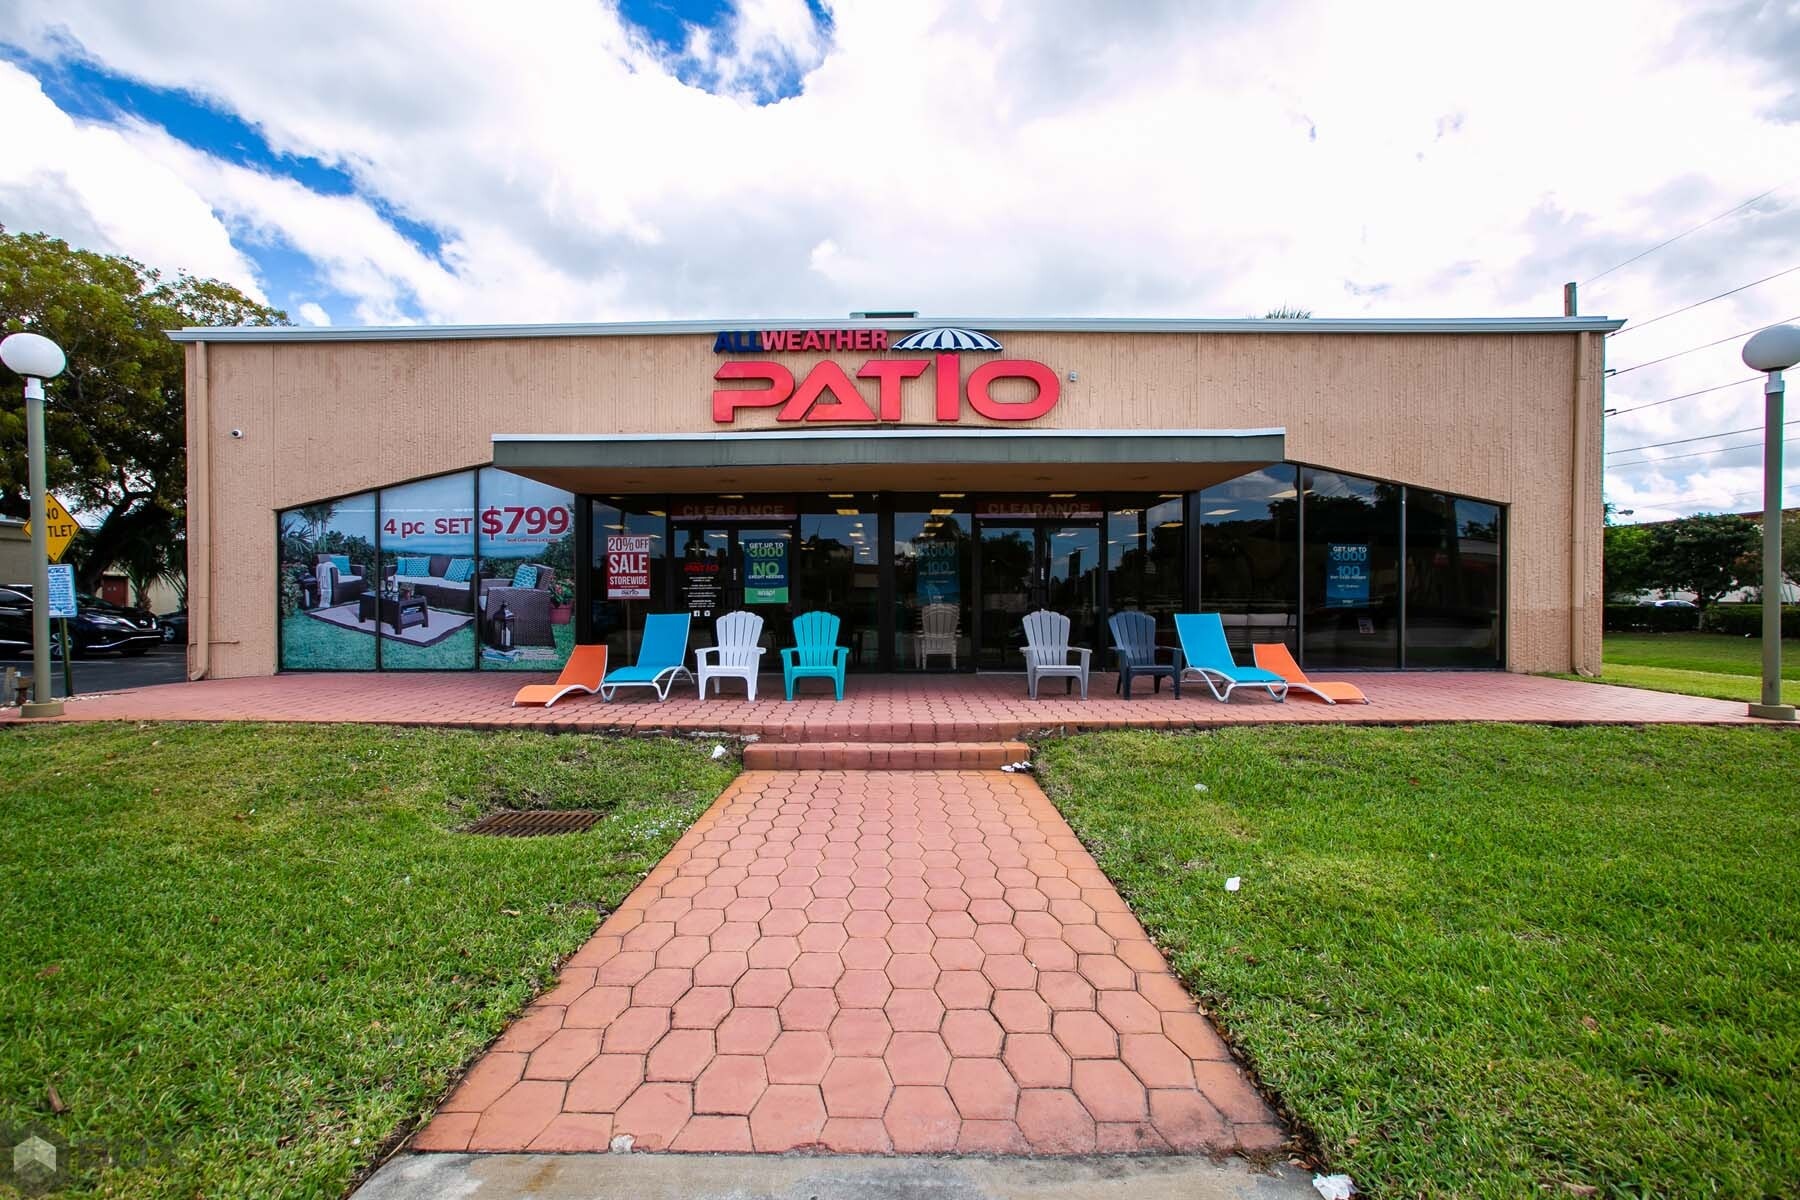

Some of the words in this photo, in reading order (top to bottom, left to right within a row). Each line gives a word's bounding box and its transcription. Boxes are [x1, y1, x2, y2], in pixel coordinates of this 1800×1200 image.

[713, 353, 1060, 422] PATIO
[682, 504, 785, 515] CLEARANCE
[987, 503, 1091, 513] CLEARANCE
[383, 518, 397, 535] 4
[401, 522, 425, 538] pc
[434, 518, 473, 535] SET
[481, 505, 570, 541] $799
[48, 525, 72, 537] TLET
[609, 537, 634, 551] 20%
[635, 539, 649, 549] OFF
[609, 553, 648, 574] SALE
[752, 561, 780, 576] NO
[1336, 566, 1360, 576] 100
[609, 575, 648, 585] STOREWIDE
